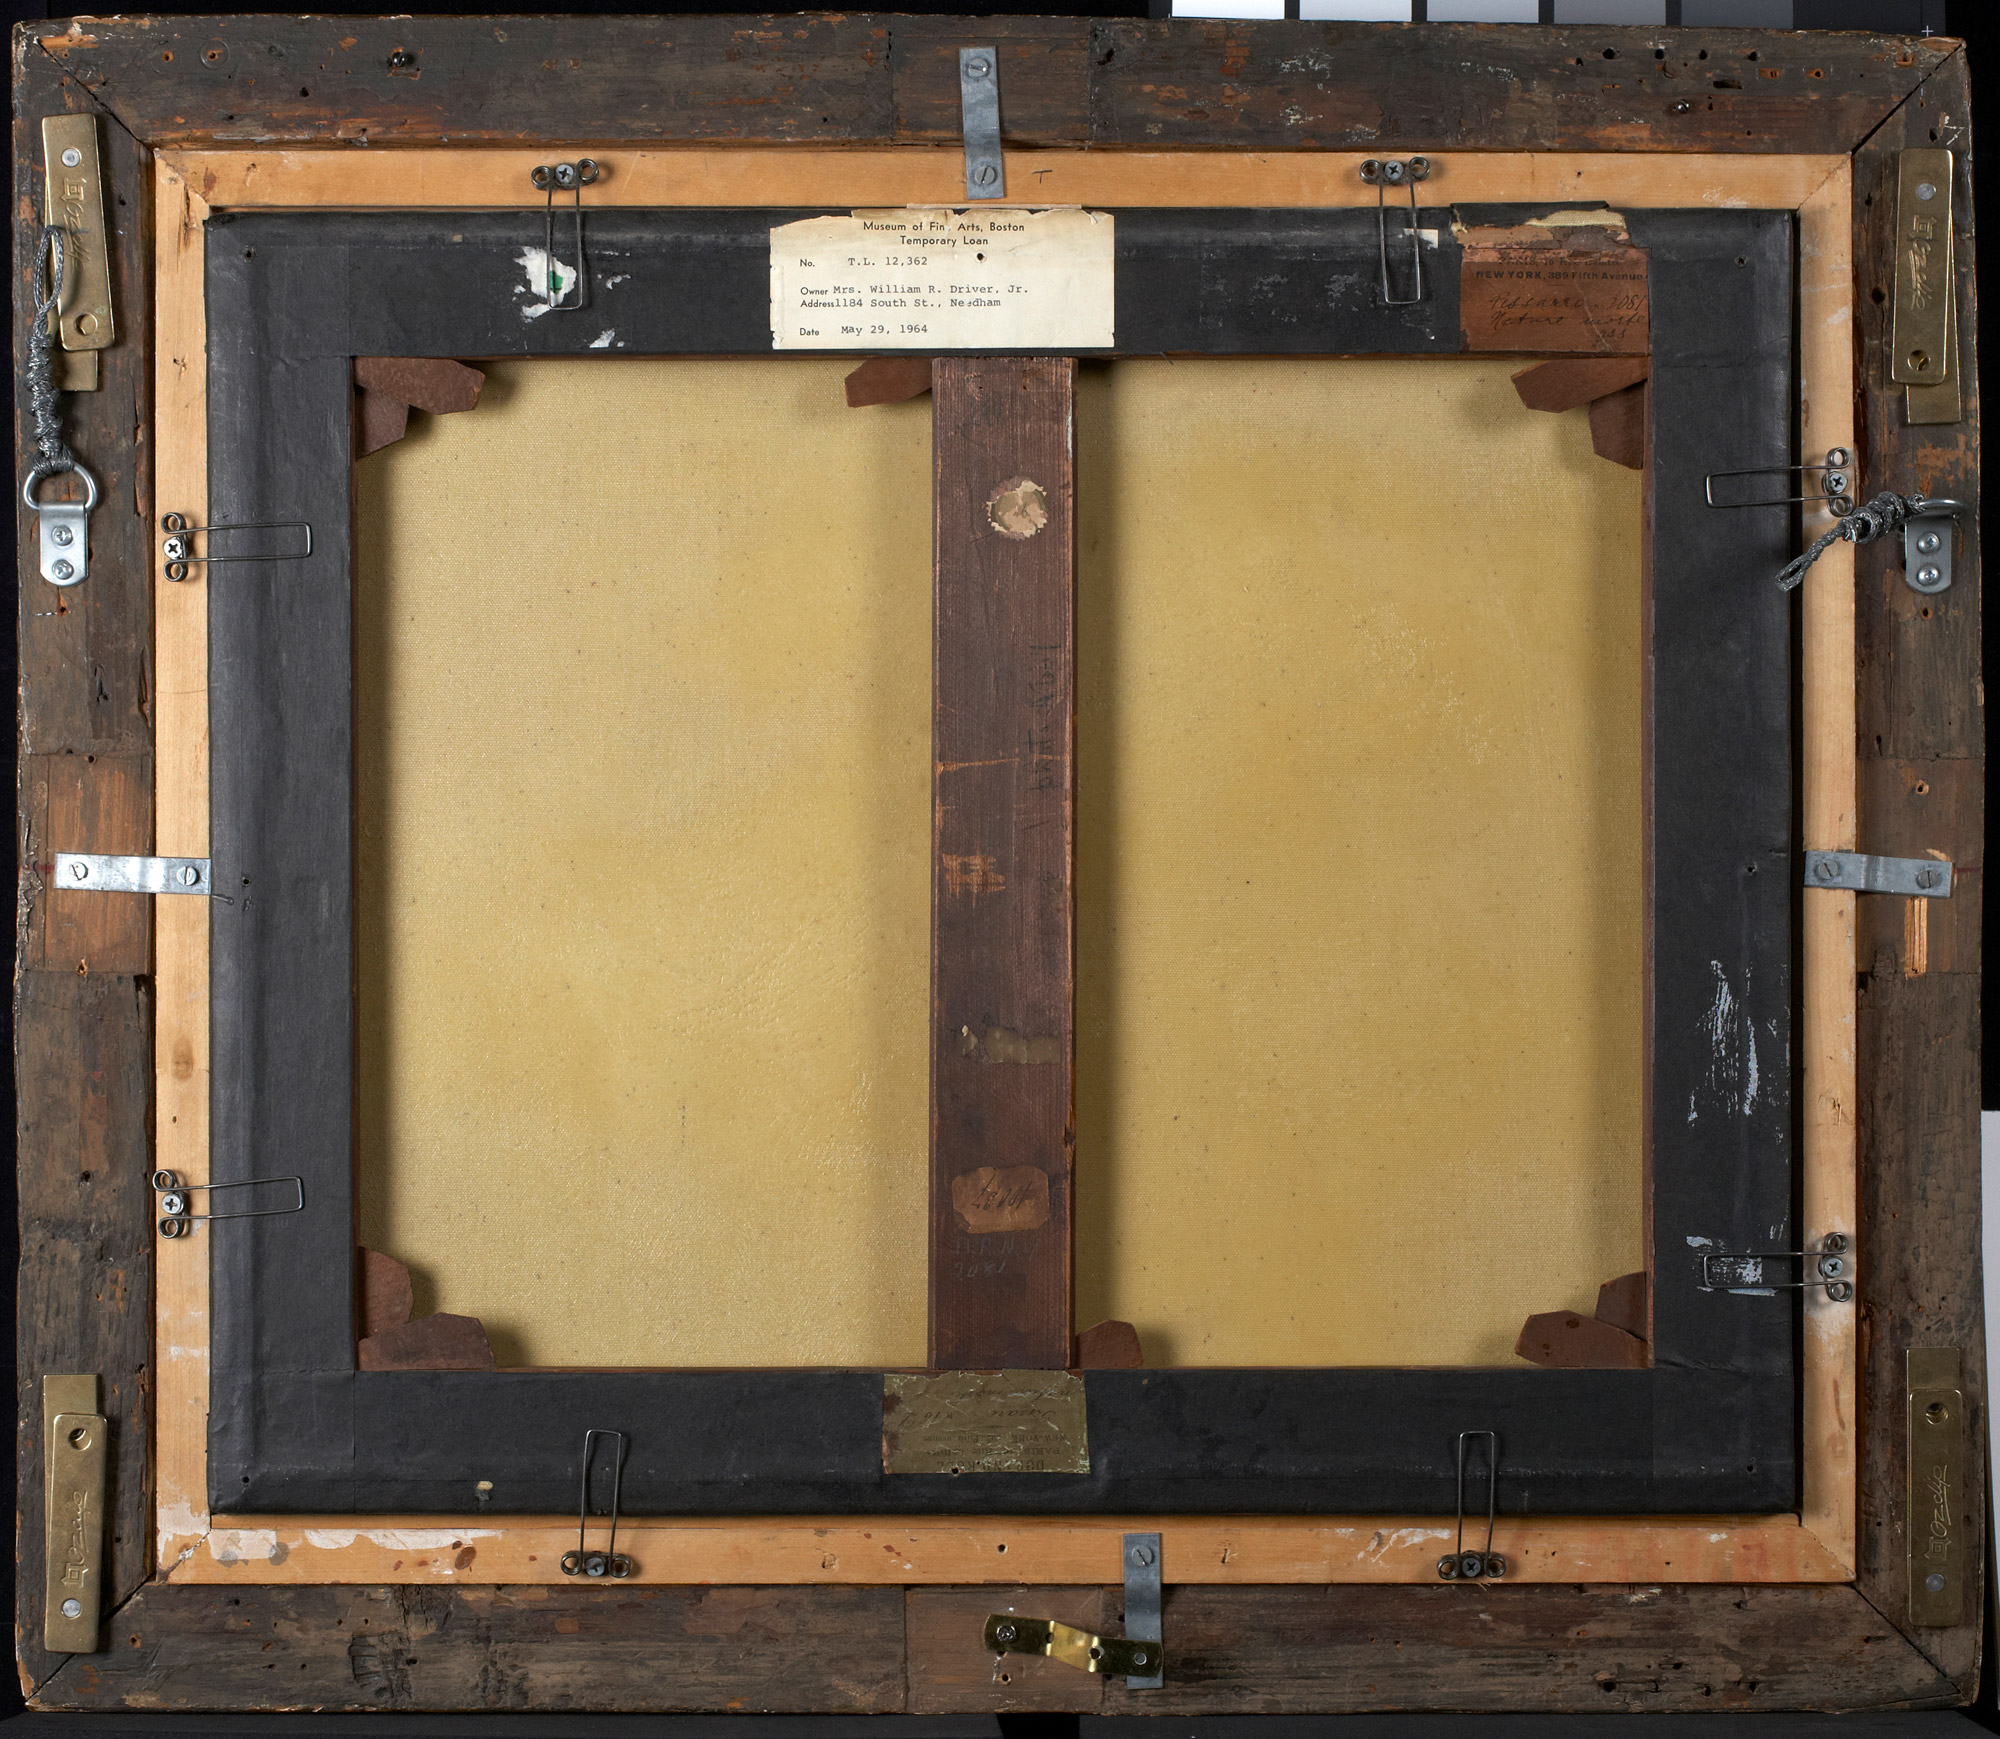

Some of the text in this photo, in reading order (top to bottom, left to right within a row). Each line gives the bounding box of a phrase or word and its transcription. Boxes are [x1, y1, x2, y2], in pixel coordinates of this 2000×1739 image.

[863, 221, 1025, 234] Museum of Fin Arts, Boston
[899, 235, 989, 248] Temporary Loan
[799, 259, 816, 268] No.
[885, 256, 928, 268] 12,362
[1475, 270, 1644, 281] NEW YORK, 389 Fifth Avenue
[800, 285, 1029, 296] Owner Mrs. William R. Driver, Jr.
[800, 299, 835, 308] Address
[870, 299, 907, 308] South
[799, 325, 928, 337] Date May 29, 1964
